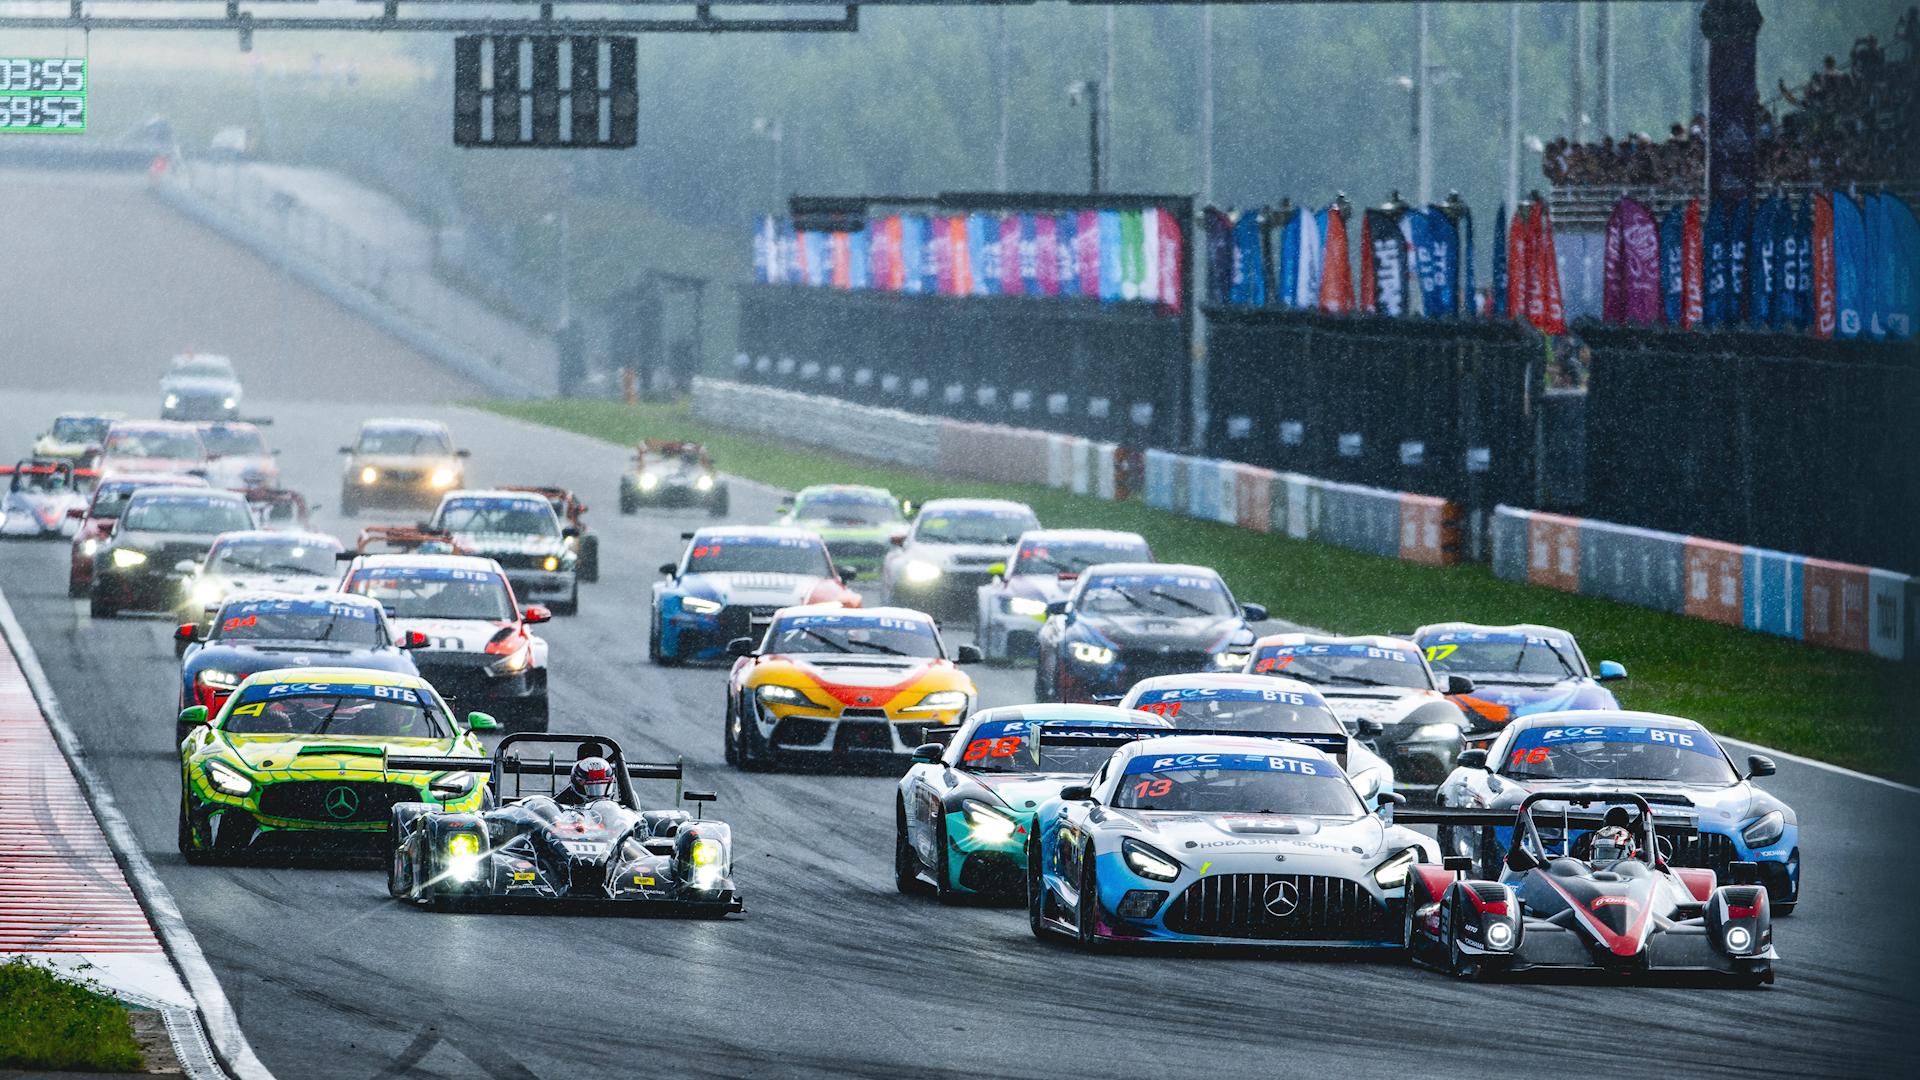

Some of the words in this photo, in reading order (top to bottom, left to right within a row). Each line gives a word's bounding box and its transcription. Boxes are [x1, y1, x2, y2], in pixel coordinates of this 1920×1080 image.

[223, 615, 257, 631] 34
[1368, 648, 1406, 662] ВТБ
[1426, 644, 1458, 661] 17
[1256, 656, 1295, 672] 37
[375, 686, 417, 702] ВТБ
[1263, 691, 1305, 706] ВТБ
[232, 702, 266, 717] 4
[1651, 729, 1694, 747] ВТБ
[963, 736, 1021, 760] 88
[1510, 747, 1551, 765] 16
[1269, 757, 1316, 775] ВТБ
[1133, 779, 1173, 798] 13
[573, 844, 597, 852] 111
